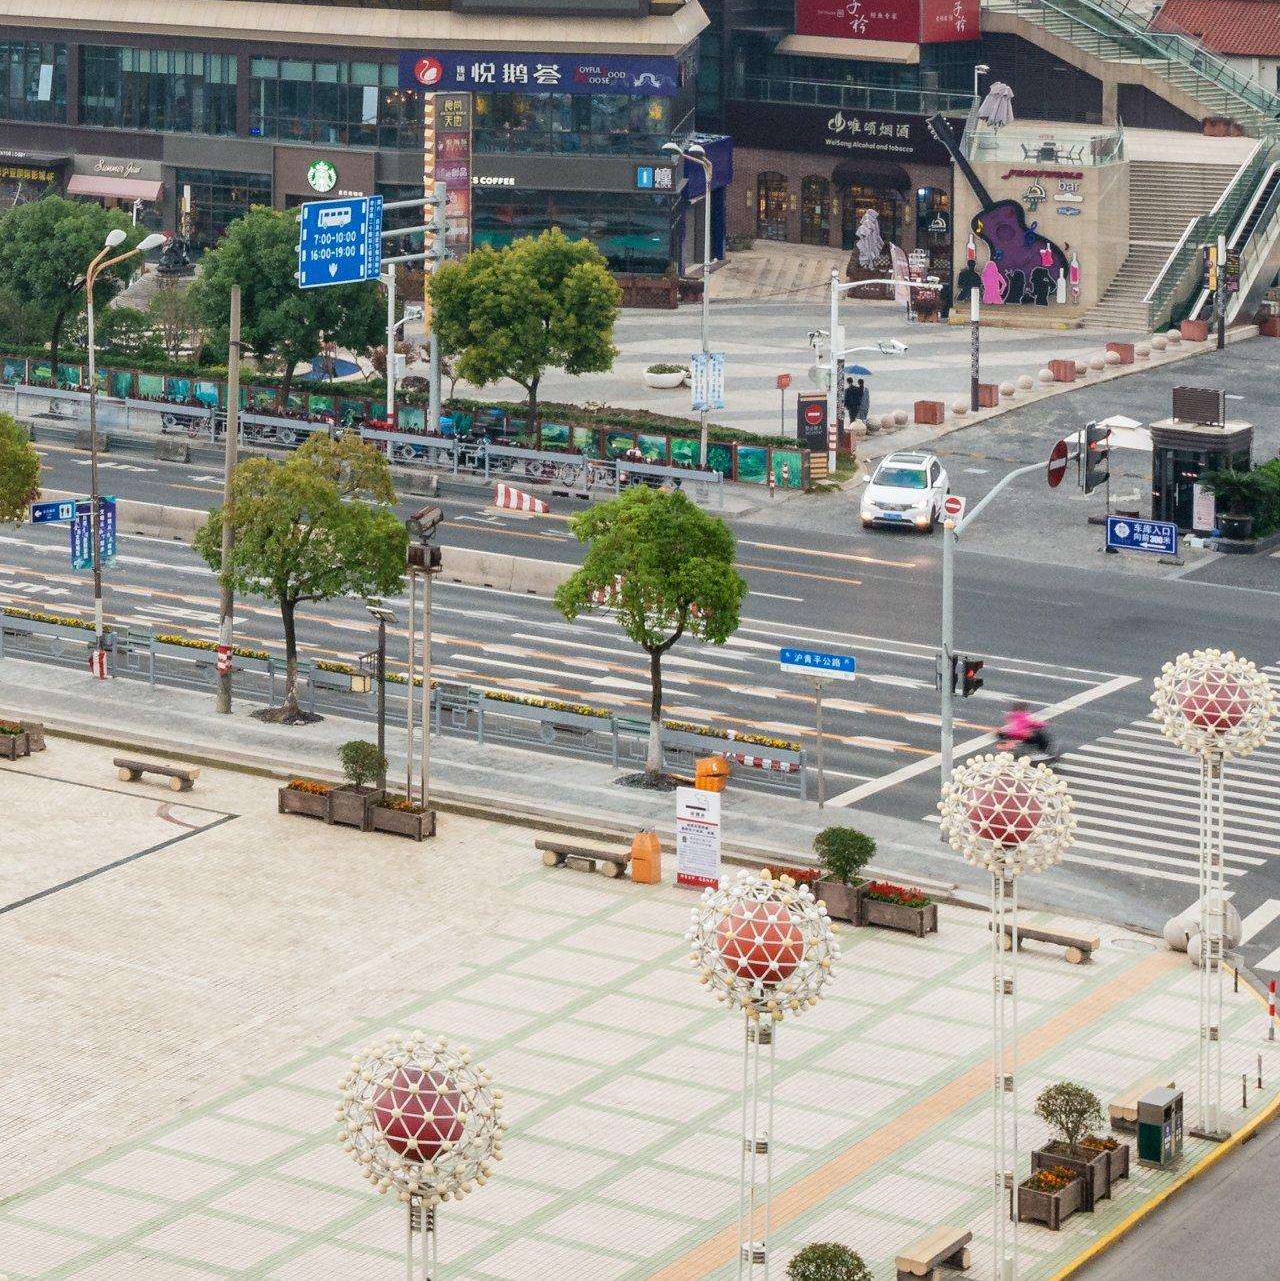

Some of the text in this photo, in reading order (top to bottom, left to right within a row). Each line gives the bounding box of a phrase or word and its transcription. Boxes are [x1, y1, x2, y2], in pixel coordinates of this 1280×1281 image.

[471, 62, 562, 85] 悦鹅荟
[847, 117, 910, 139] 唯颂烟酒
[852, 141, 875, 149] Alcohol
[889, 145, 914, 153] tobacco
[480, 177, 515, 186] COFFEE
[1058, 179, 1080, 191] bar
[313, 231, 357, 245] 7:00-10:00
[310, 245, 356, 261] 16:00-19:00
[1133, 524, 1170, 536] 车库入口
[794, 653, 841, 668] 沪青平公路
